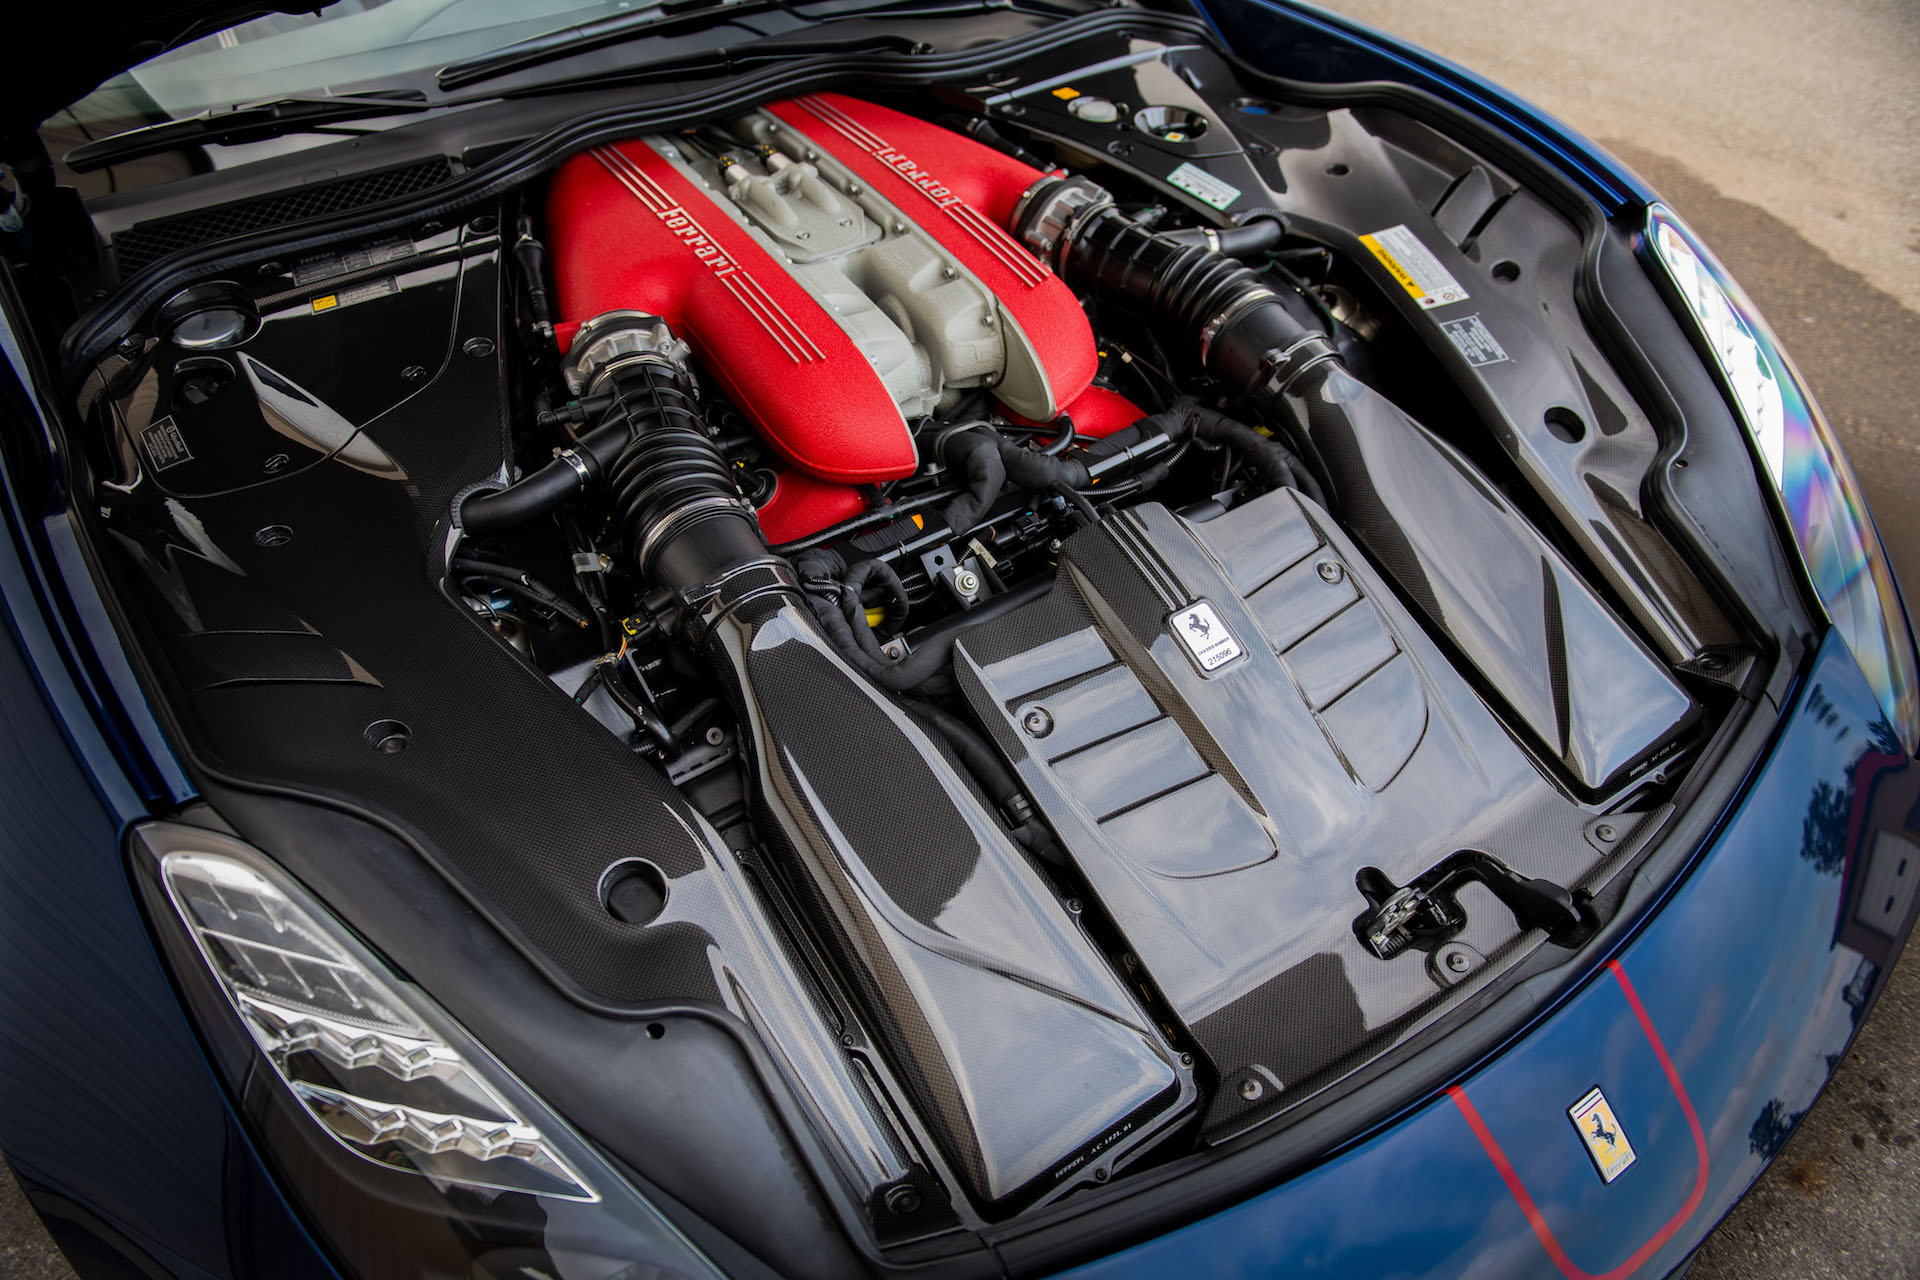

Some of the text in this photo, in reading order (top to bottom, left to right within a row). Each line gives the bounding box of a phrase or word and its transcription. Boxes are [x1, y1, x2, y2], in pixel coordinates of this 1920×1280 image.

[873, 147, 963, 209] Ferrari
[656, 207, 742, 277] Ferrari
[1376, 249, 1407, 280] WARNING
[1197, 636, 1230, 656] CHASSIS NUMBER
[1207, 647, 1233, 666] 215096
[1606, 1152, 1634, 1178] Ferrari
